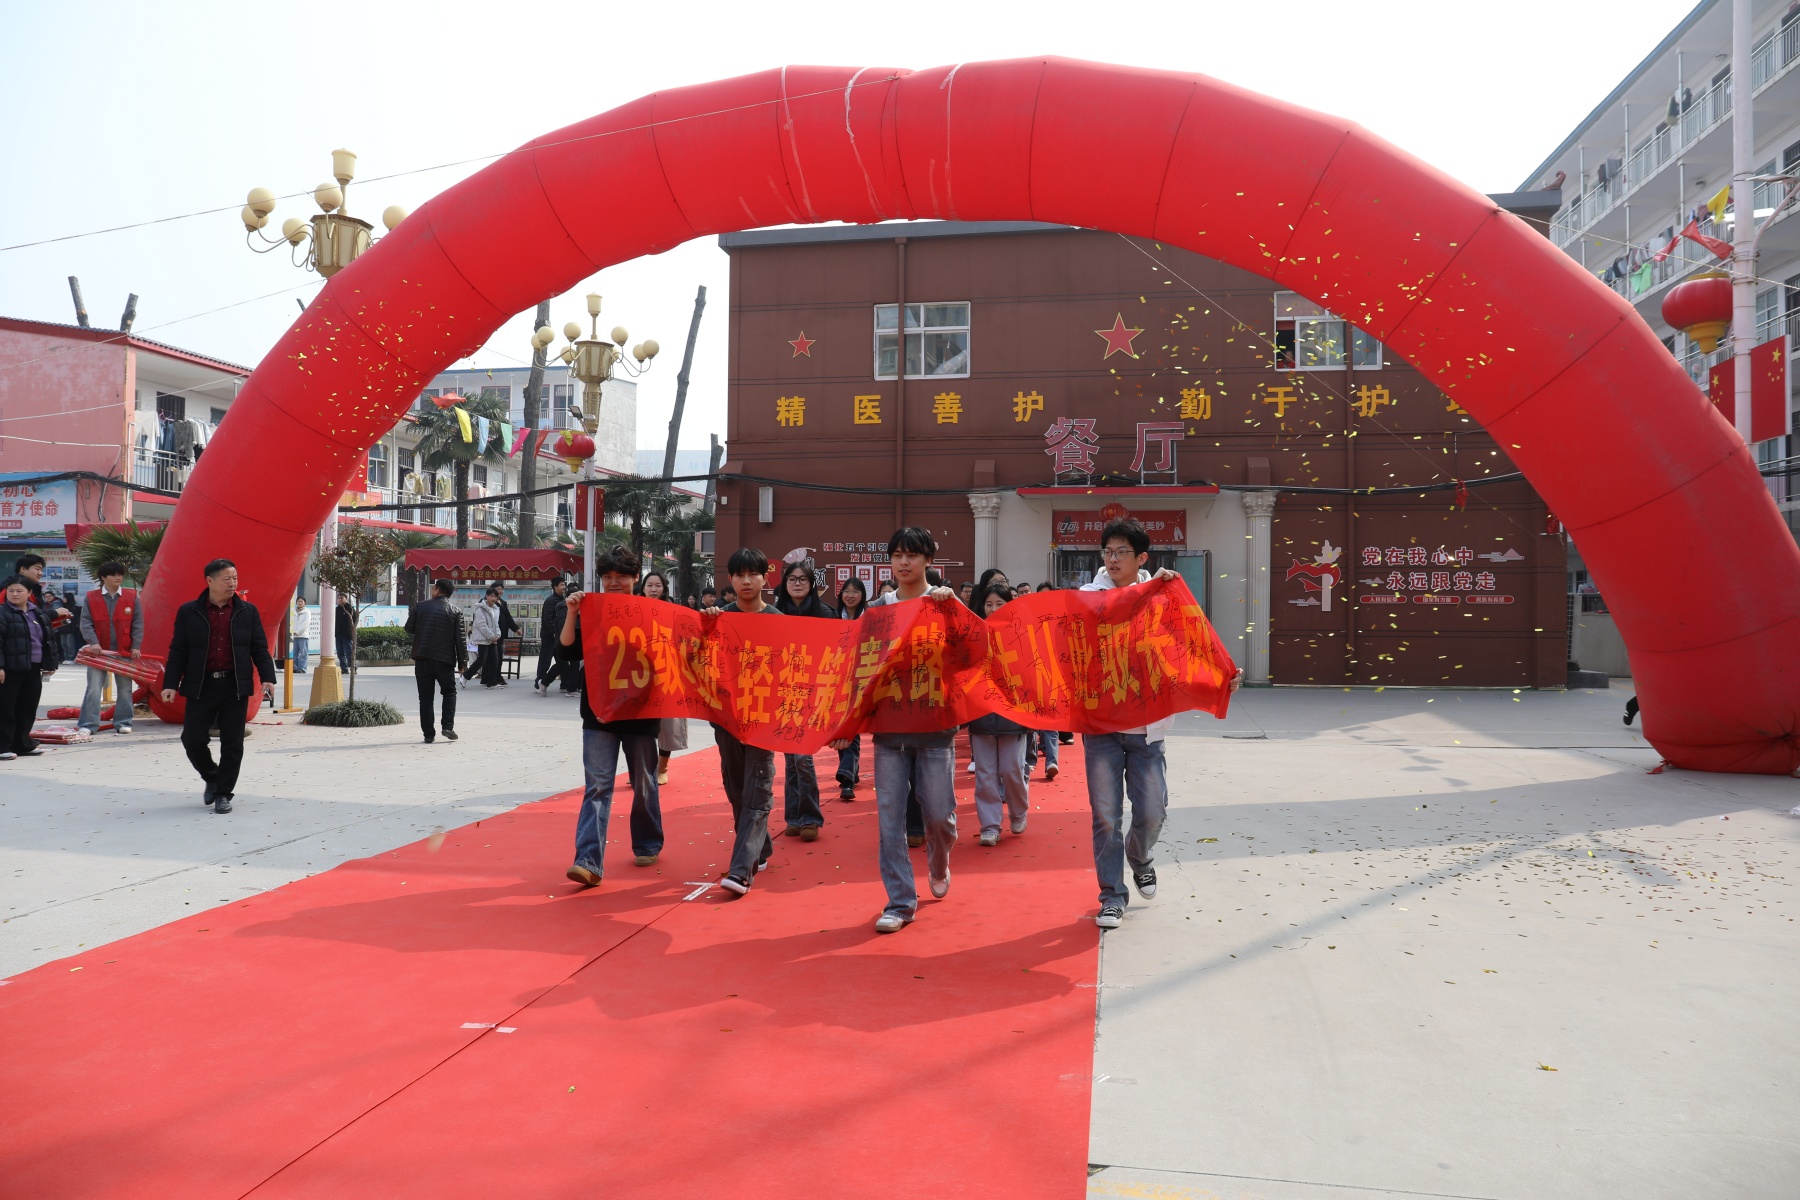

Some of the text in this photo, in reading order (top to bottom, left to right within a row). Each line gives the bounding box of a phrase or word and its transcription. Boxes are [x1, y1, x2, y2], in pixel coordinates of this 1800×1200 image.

[776, 390, 1044, 427] 精医善护
[1044, 417, 1185, 474] 餐厅
[1362, 546, 1474, 566] 党在我心中
[461, 570, 540, 579] 漯河卫生中等专业学校
[1386, 571, 1496, 591] 永远跟党走
